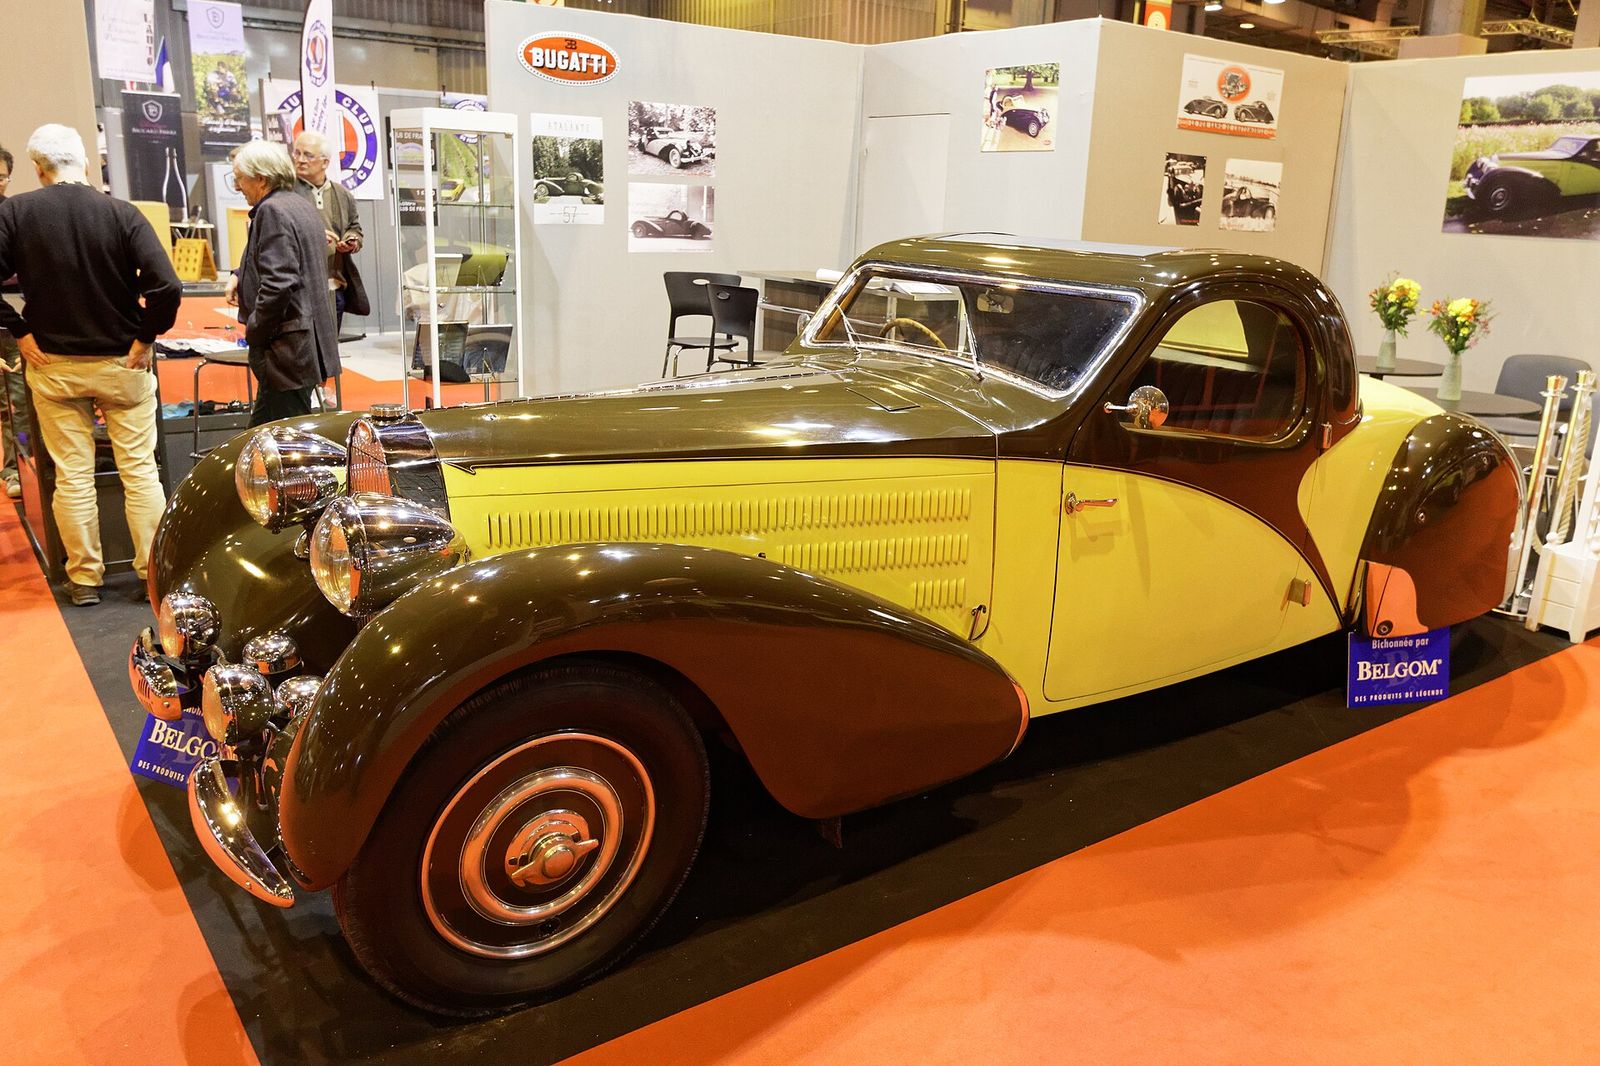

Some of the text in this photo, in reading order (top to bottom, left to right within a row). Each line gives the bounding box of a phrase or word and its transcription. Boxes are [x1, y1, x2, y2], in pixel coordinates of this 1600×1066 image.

[531, 47, 607, 75] BUGATTI
[342, 96, 374, 135] CLUB
[562, 206, 577, 224] 57
[1372, 638, 1429, 649] Bichonnée par
[1355, 695, 1367, 703] DES
[1369, 692, 1402, 701] PRODUITS
[148, 719, 219, 759] BELGO
[138, 760, 185, 782] DES PRODUITS
